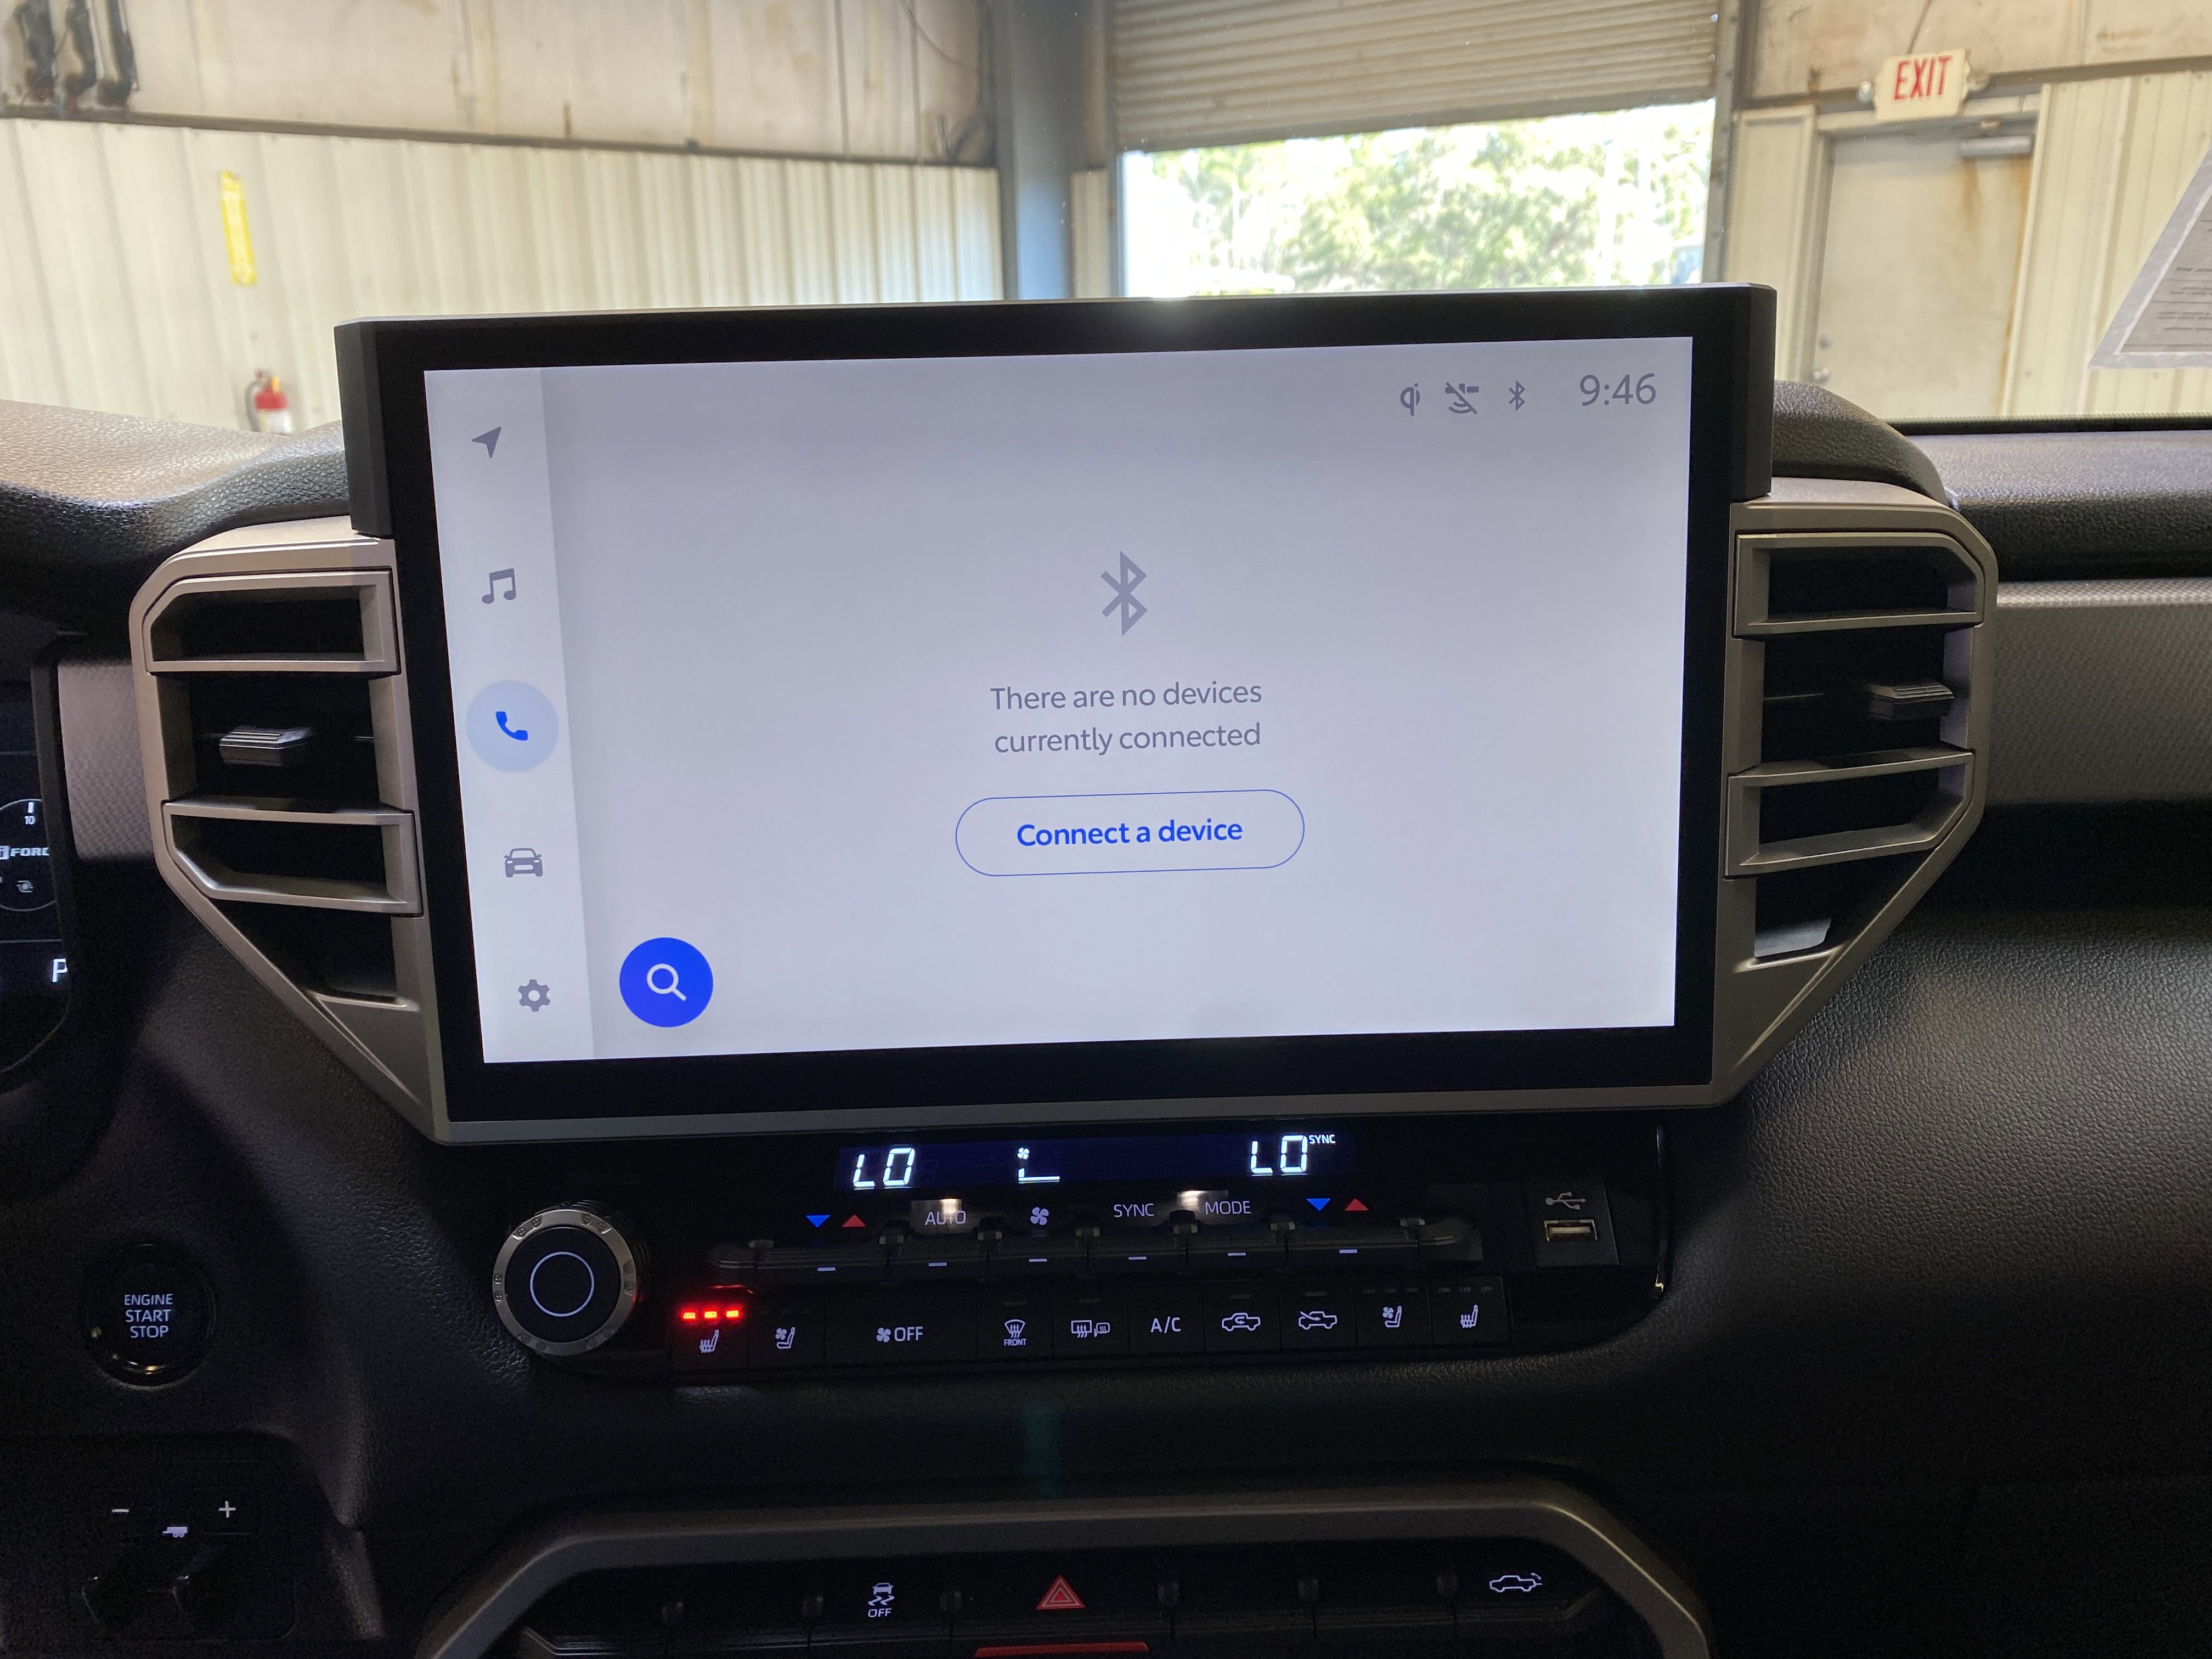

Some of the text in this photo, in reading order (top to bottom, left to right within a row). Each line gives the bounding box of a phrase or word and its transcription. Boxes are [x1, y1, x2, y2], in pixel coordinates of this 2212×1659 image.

[1894, 54, 1953, 100] EXIT
[1579, 373, 1657, 407] 9:46
[990, 680, 1262, 710] There are no devices
[994, 722, 1261, 756] currently connected
[24, 815, 36, 825] 10
[1017, 818, 1243, 847] Connect a device
[52, 958, 68, 983] P
[1308, 1134, 1336, 1144] SYNC
[1114, 1203, 1155, 1218] SYNC
[1205, 1200, 1252, 1215] MODE
[924, 1210, 967, 1226] AUTO
[124, 1293, 173, 1306] ENGINE
[126, 1309, 172, 1323] START
[130, 1325, 169, 1338] STOP
[1150, 1316, 1181, 1334] A/C
[894, 1326, 924, 1342] OFF
[1003, 1338, 1027, 1346] FRONT
[867, 1607, 892, 1618] OFF
